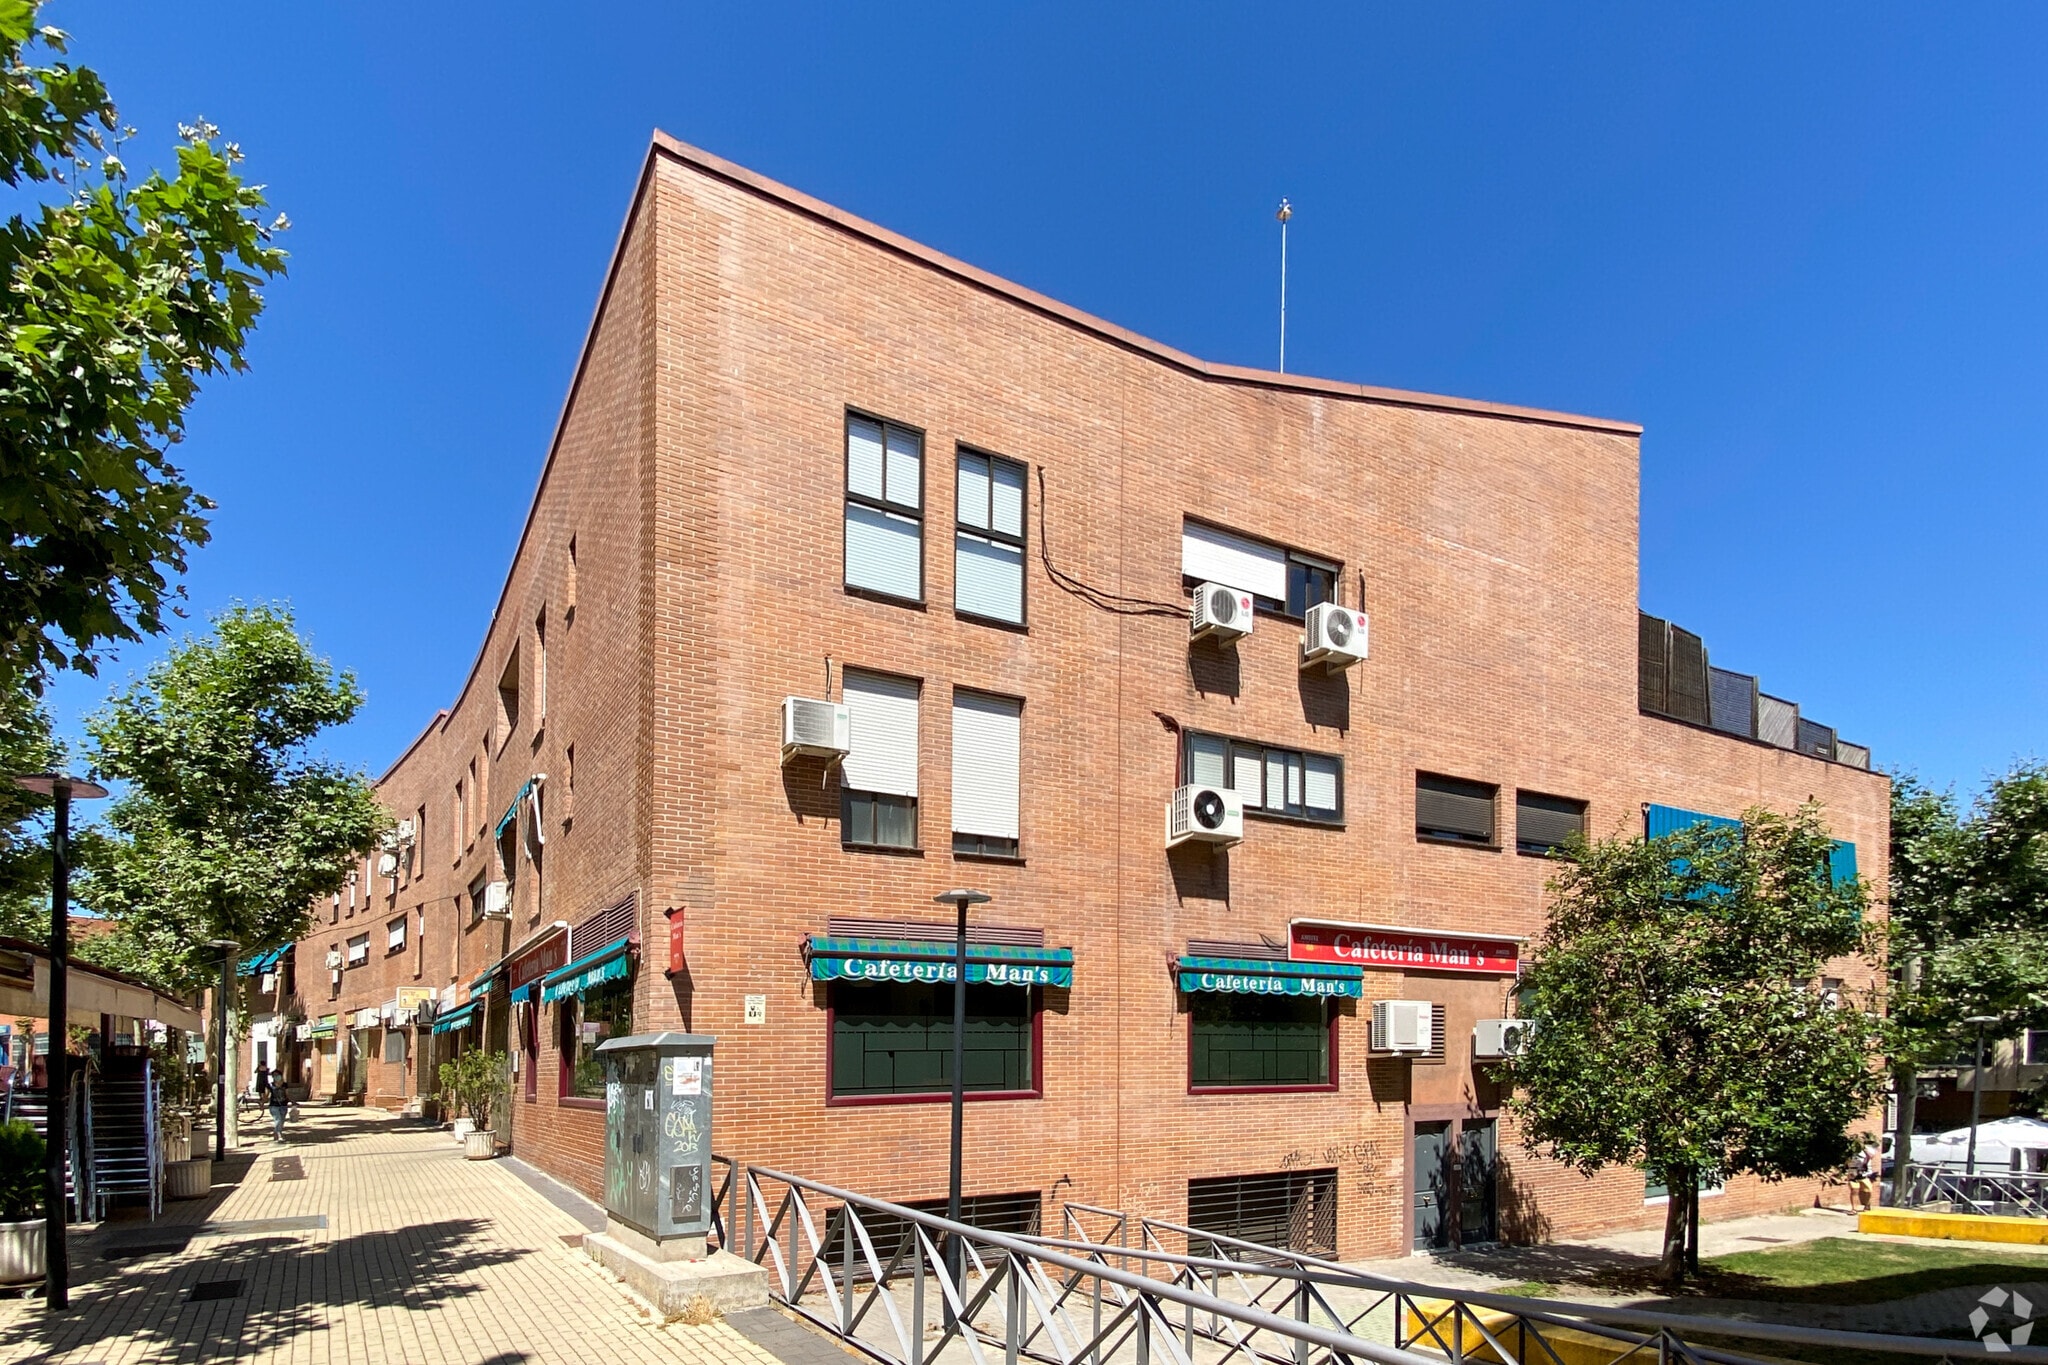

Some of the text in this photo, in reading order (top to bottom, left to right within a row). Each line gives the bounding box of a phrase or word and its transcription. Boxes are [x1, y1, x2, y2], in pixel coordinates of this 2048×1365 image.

[1334, 933, 1424, 962] Cafetería
[985, 963, 1048, 983] Man's
[1300, 977, 1345, 994] Man's
